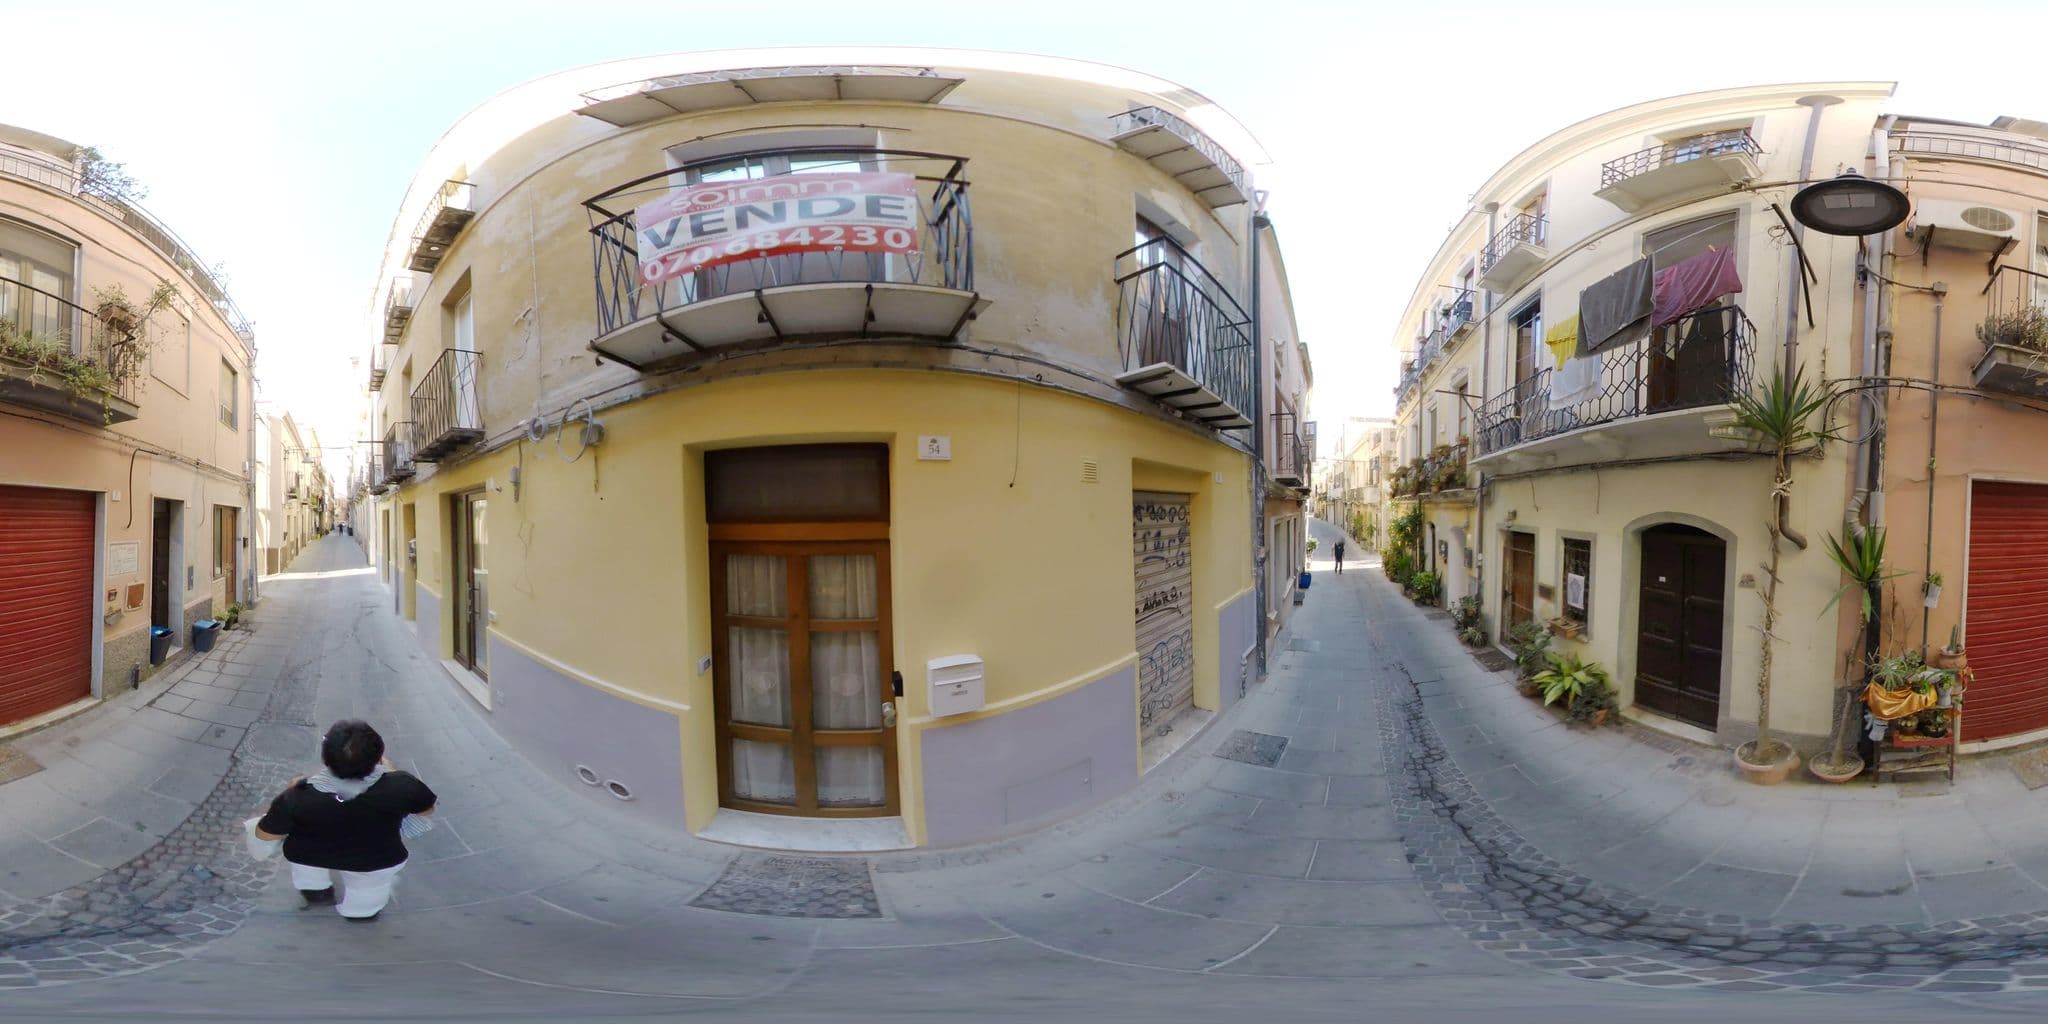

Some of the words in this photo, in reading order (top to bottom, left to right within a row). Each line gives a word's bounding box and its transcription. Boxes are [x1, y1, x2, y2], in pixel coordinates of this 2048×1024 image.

[643, 195, 908, 250] VENDE
[644, 226, 911, 281] 070.684230
[928, 444, 940, 455] 54
